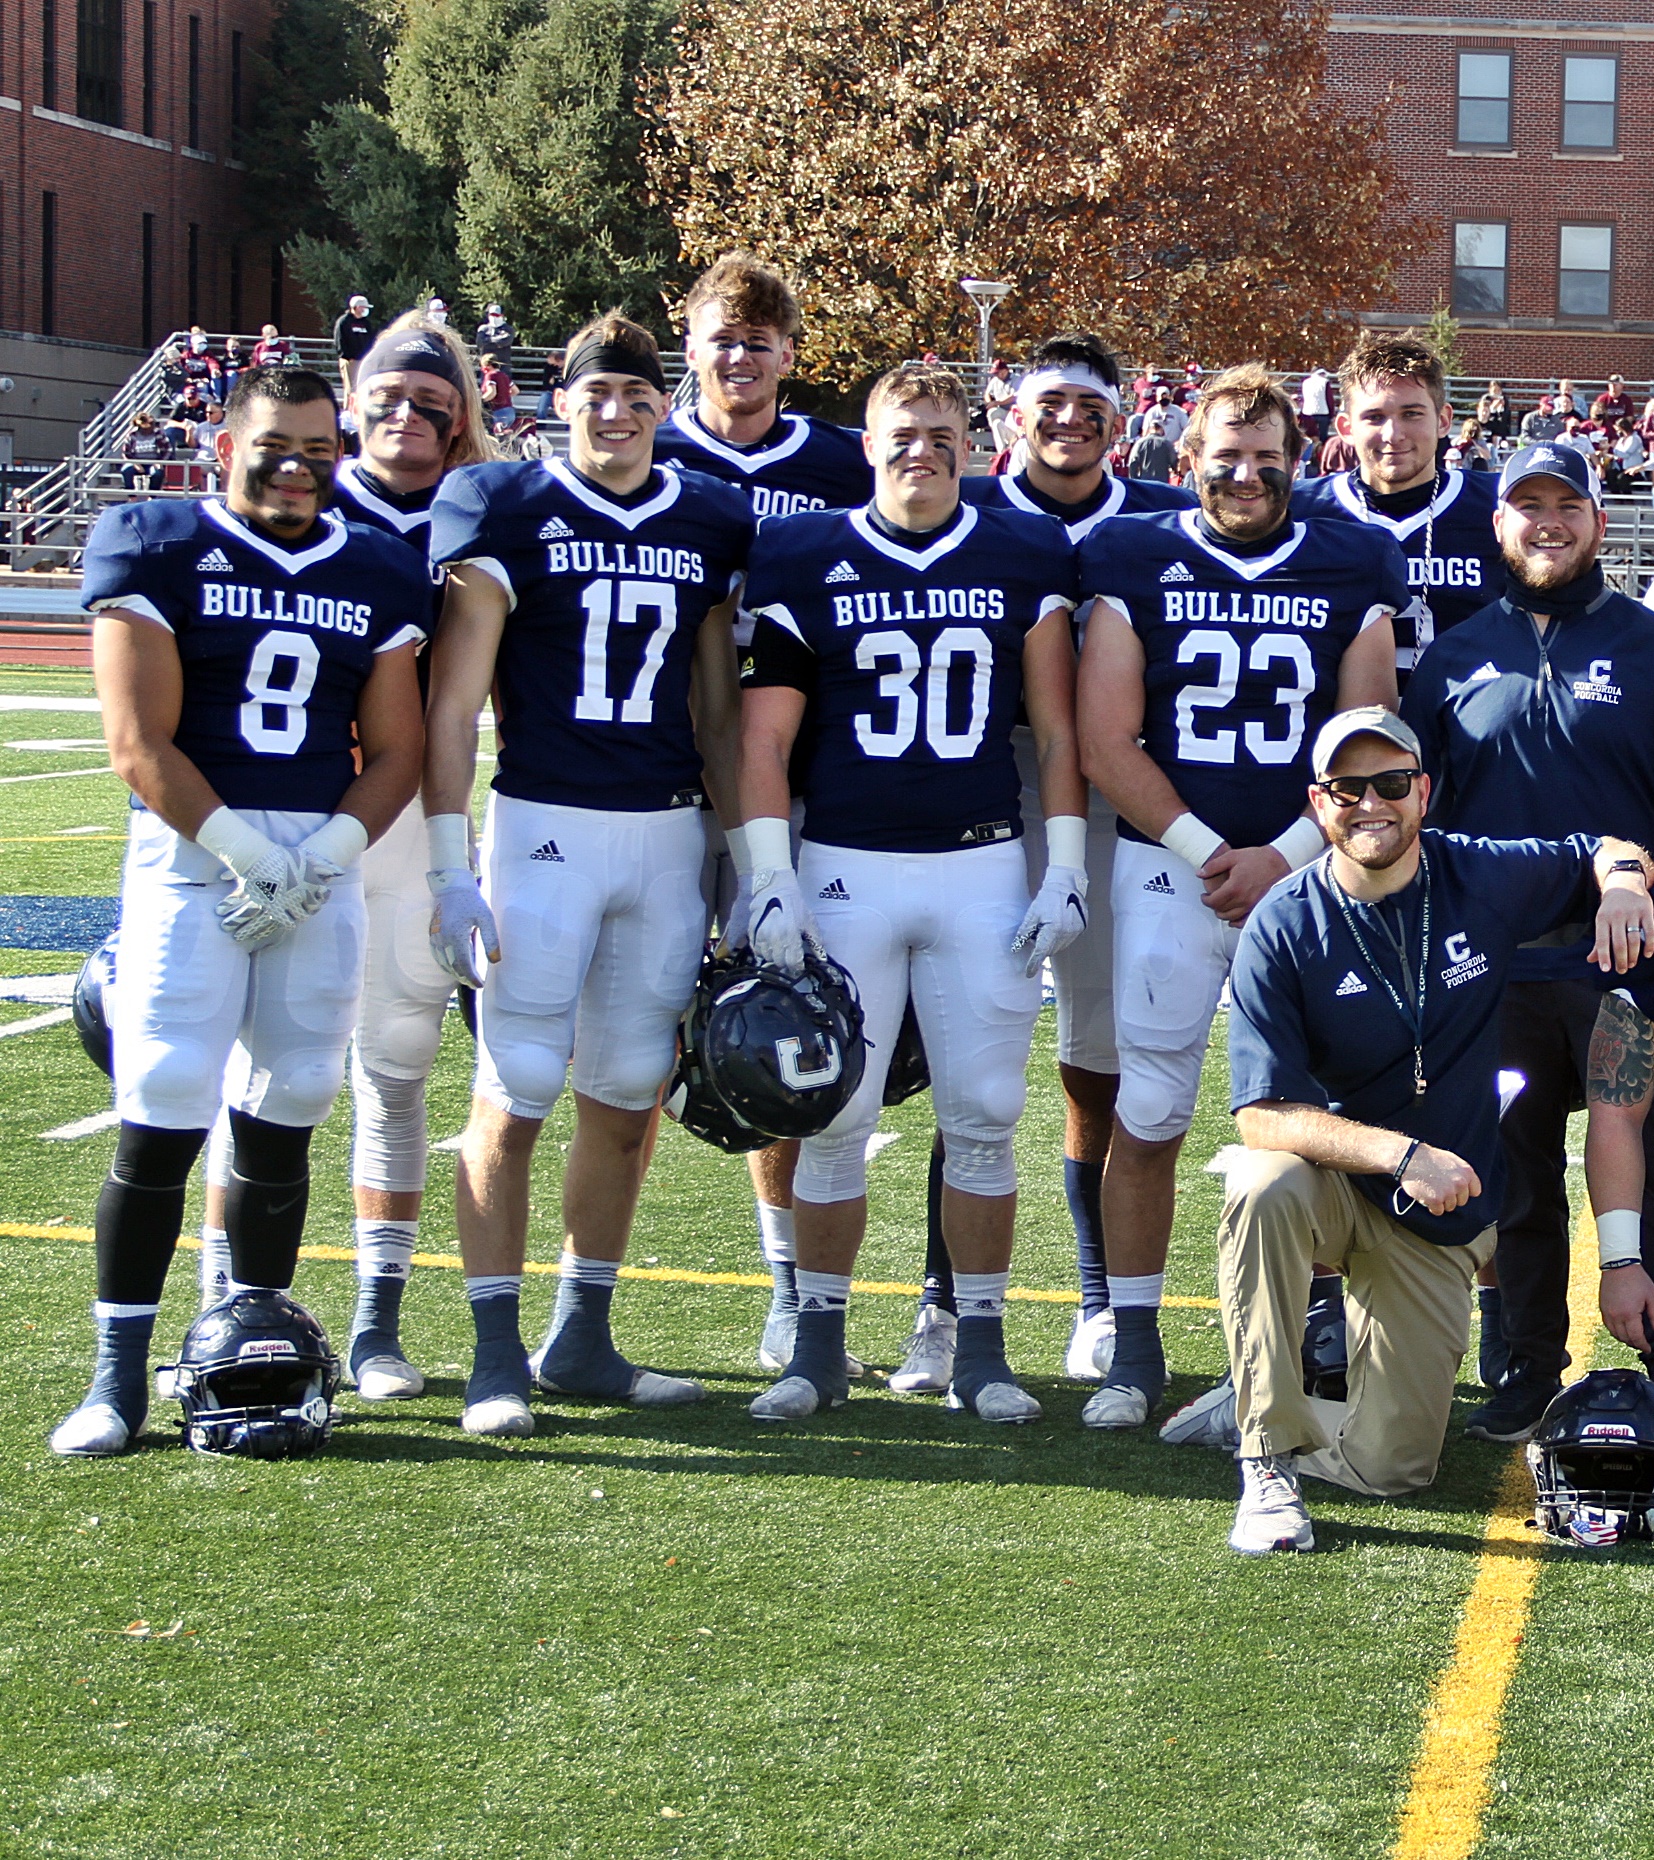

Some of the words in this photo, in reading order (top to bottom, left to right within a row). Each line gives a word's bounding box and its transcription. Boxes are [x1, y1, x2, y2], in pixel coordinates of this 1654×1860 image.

[394, 345, 440, 357] adidas
[539, 527, 574, 540] adidas
[196, 562, 234, 572] adidas
[548, 541, 704, 583] BULLDOGS
[1407, 557, 1482, 587] DOGS
[825, 572, 860, 584] adidas
[1160, 573, 1194, 583] adidas
[203, 583, 372, 637] BULLDOGS
[833, 588, 1004, 627] BULLDOGS
[1164, 591, 1330, 629] BULLDOGS
[575, 578, 677, 722] 17
[1588, 659, 1612, 685] C
[240, 630, 320, 754] 8
[854, 627, 993, 759] 30
[1176, 629, 1317, 764] 23
[1573, 681, 1622, 696] CONCORDIA
[1574, 690, 1619, 705] FOOTBALL
[530, 853, 565, 863] adidas
[819, 891, 850, 900] adidas
[1143, 884, 1175, 895] adidas
[1342, 909, 1371, 963] UNIVERSITY
[1444, 931, 1472, 964] C
[1441, 953, 1487, 980] CONCORDIA
[1445, 964, 1489, 989] FOOTBALL
[1335, 983, 1368, 996] adidas
[1587, 1426, 1630, 1437] Riddell
